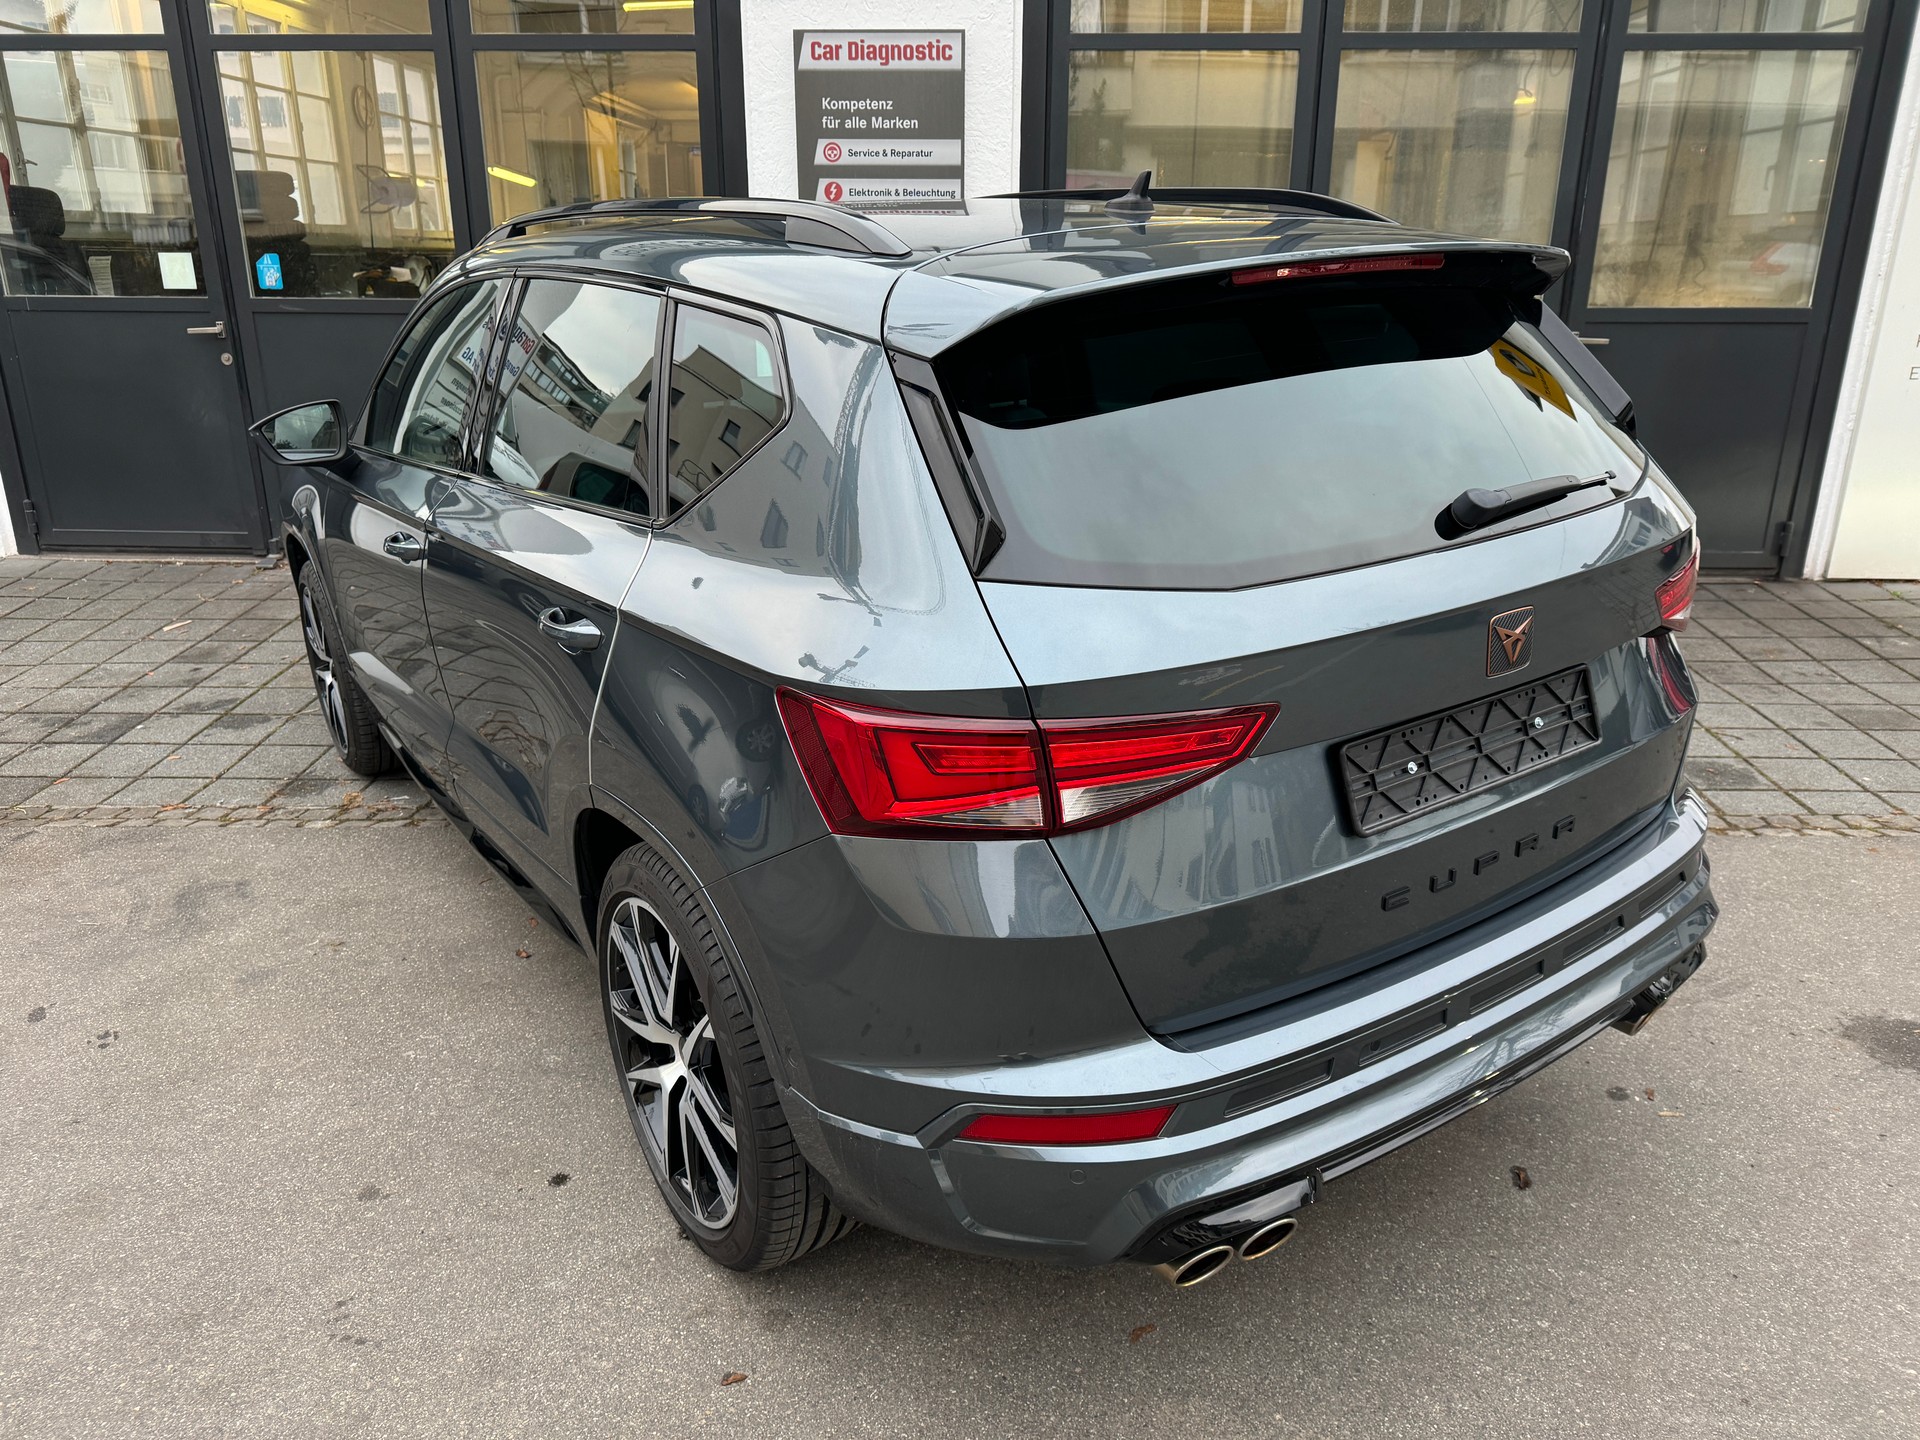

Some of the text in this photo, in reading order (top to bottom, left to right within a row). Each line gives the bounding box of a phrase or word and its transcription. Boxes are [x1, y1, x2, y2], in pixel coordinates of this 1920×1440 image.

[810, 39, 953, 66] Car Diagnostic
[822, 97, 893, 112] Kompetenz
[822, 116, 919, 129] für alle Marken
[847, 148, 933, 160] Service & Reparatur
[849, 188, 956, 199] Elektronik & Beleuchtung
[1380, 814, 1577, 912] CUPRA
